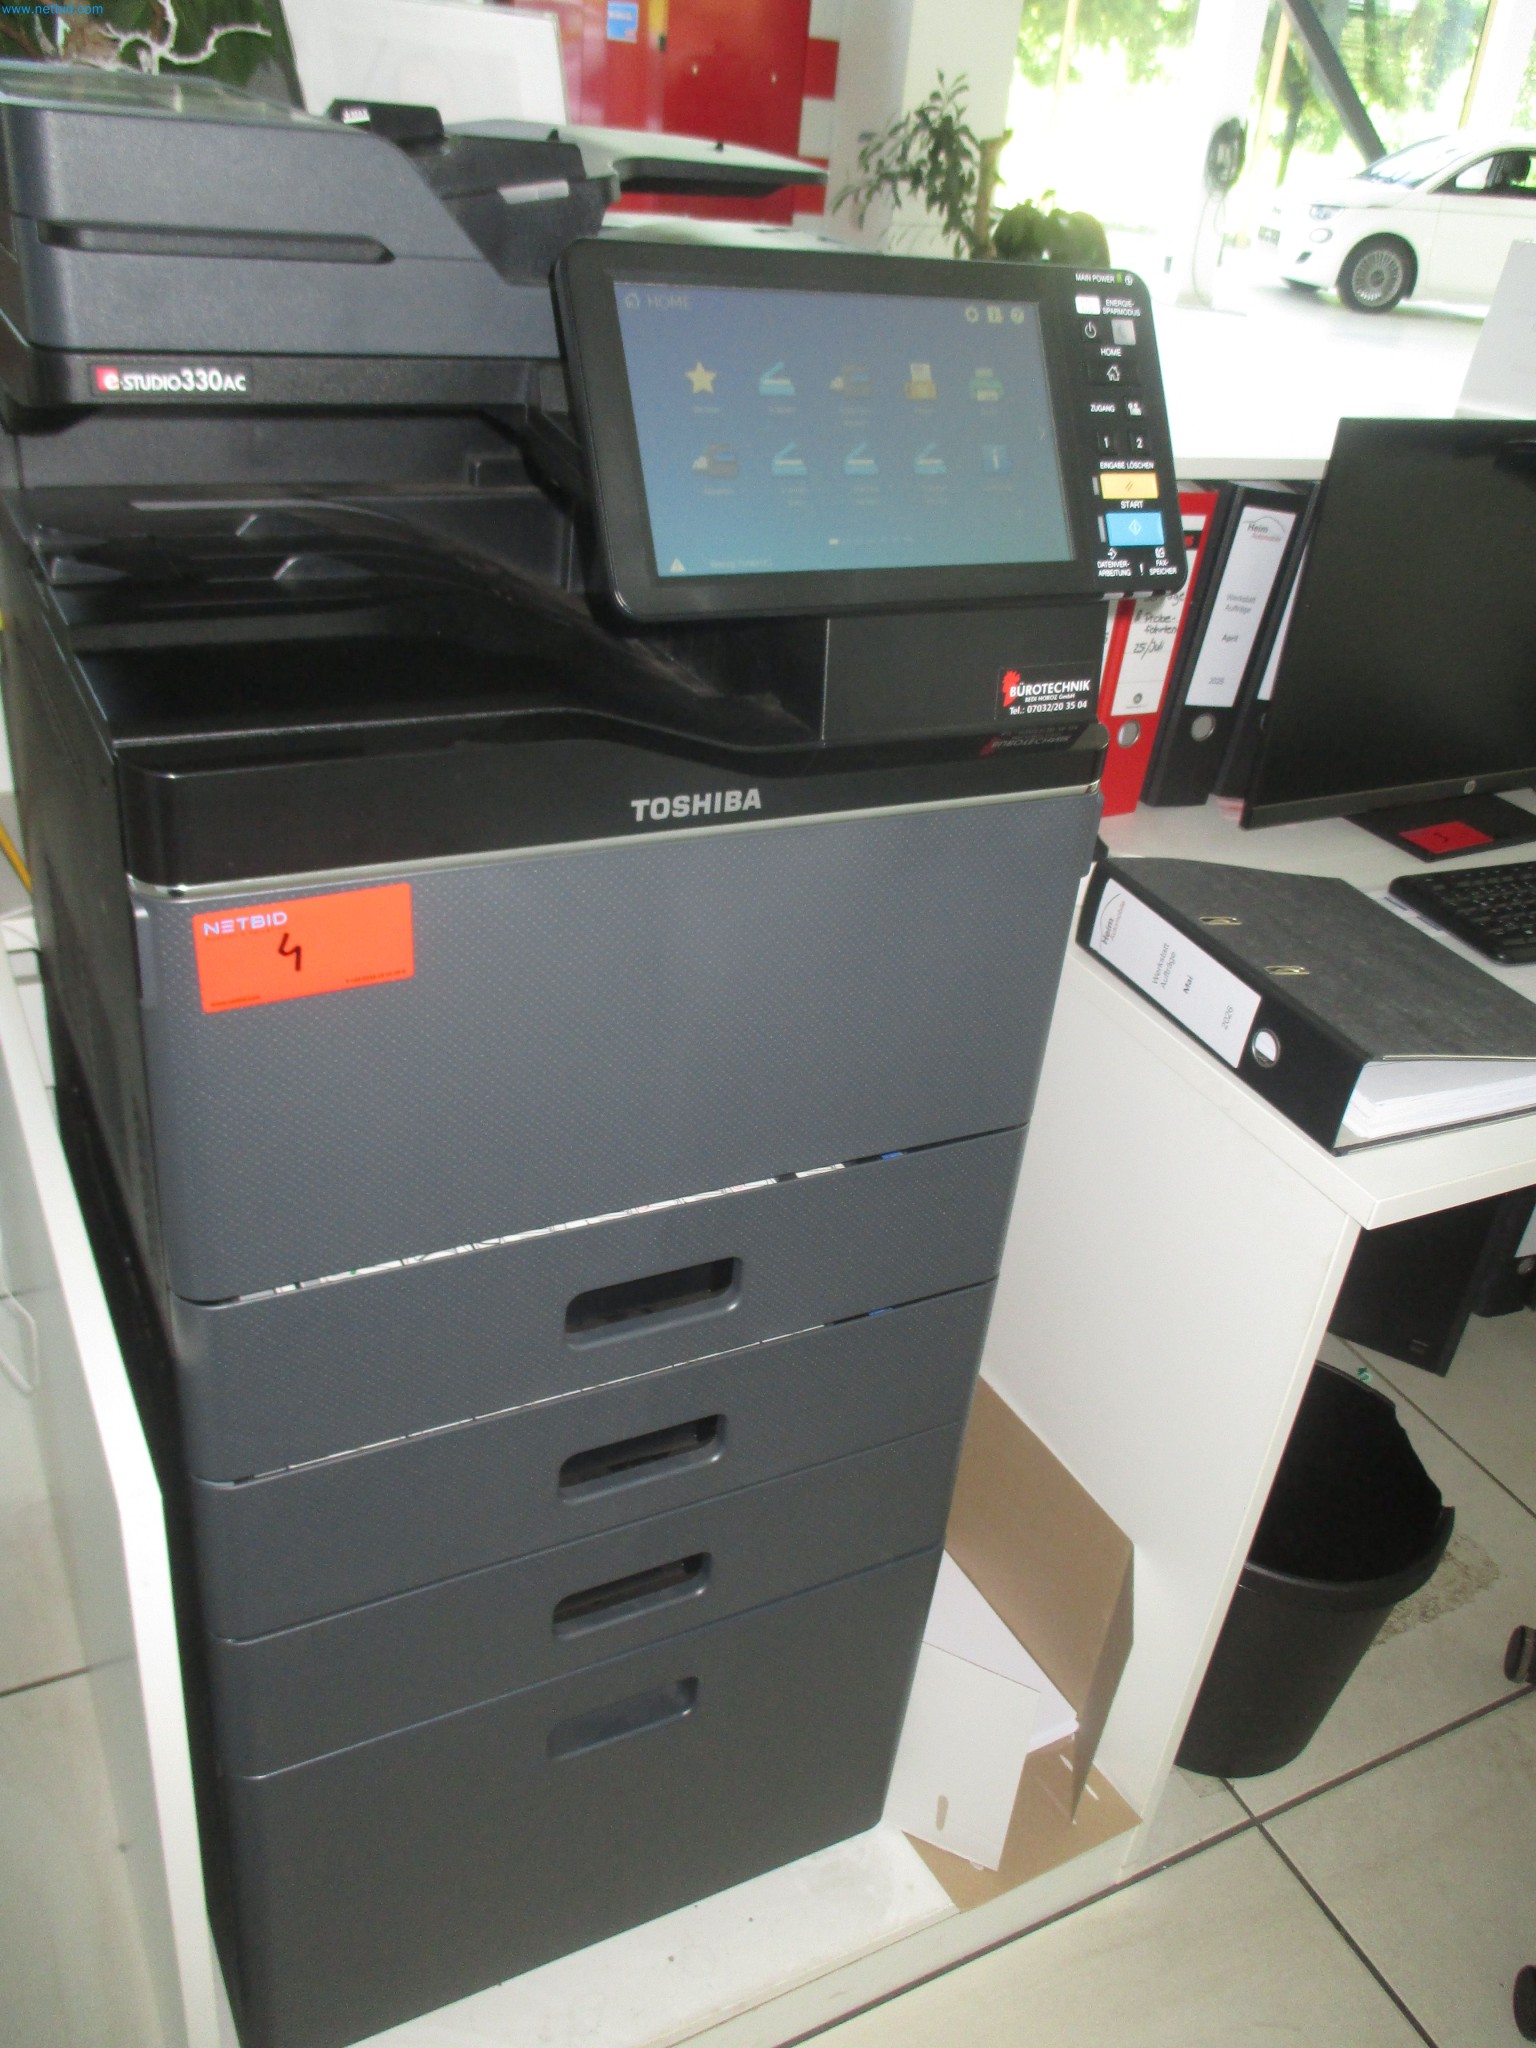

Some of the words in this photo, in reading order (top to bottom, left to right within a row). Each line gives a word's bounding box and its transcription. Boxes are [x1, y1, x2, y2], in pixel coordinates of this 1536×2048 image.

[1075, 273, 1092, 282] MAIN
[1092, 274, 1115, 283] POWER
[1102, 307, 1141, 317] SPARMODUS
[1100, 348, 1122, 357] HOME
[1090, 404, 1116, 413] ZUGANG
[1103, 436, 1109, 448] 1
[1136, 436, 1144, 449] 2
[1100, 461, 1126, 469] EINGABE
[1126, 460, 1154, 469] LÖSCHEN
[1120, 500, 1144, 509] START
[1097, 560, 1130, 569] DATENVER-
[1149, 566, 1178, 576] SPEICHER
[1098, 568, 1132, 577] ARBEITUNG
[1222, 634, 1239, 643] April
[1009, 680, 1091, 698] BÜROTECHNIK
[1009, 705, 1025, 716] Tel.:
[1027, 702, 1064, 714] 07032/20
[1065, 701, 1075, 710] 35
[1077, 700, 1088, 709] 04
[630, 788, 762, 822] TOSHIBA
[203, 911, 288, 936] NETBID
[1101, 917, 1114, 945] Heim
[277, 932, 303, 972] 4
[1151, 942, 1170, 985] Werkstatt
[1161, 951, 1177, 990] Aufträge
[1182, 975, 1194, 994] Mai
[1221, 1005, 1235, 1031] 2026
